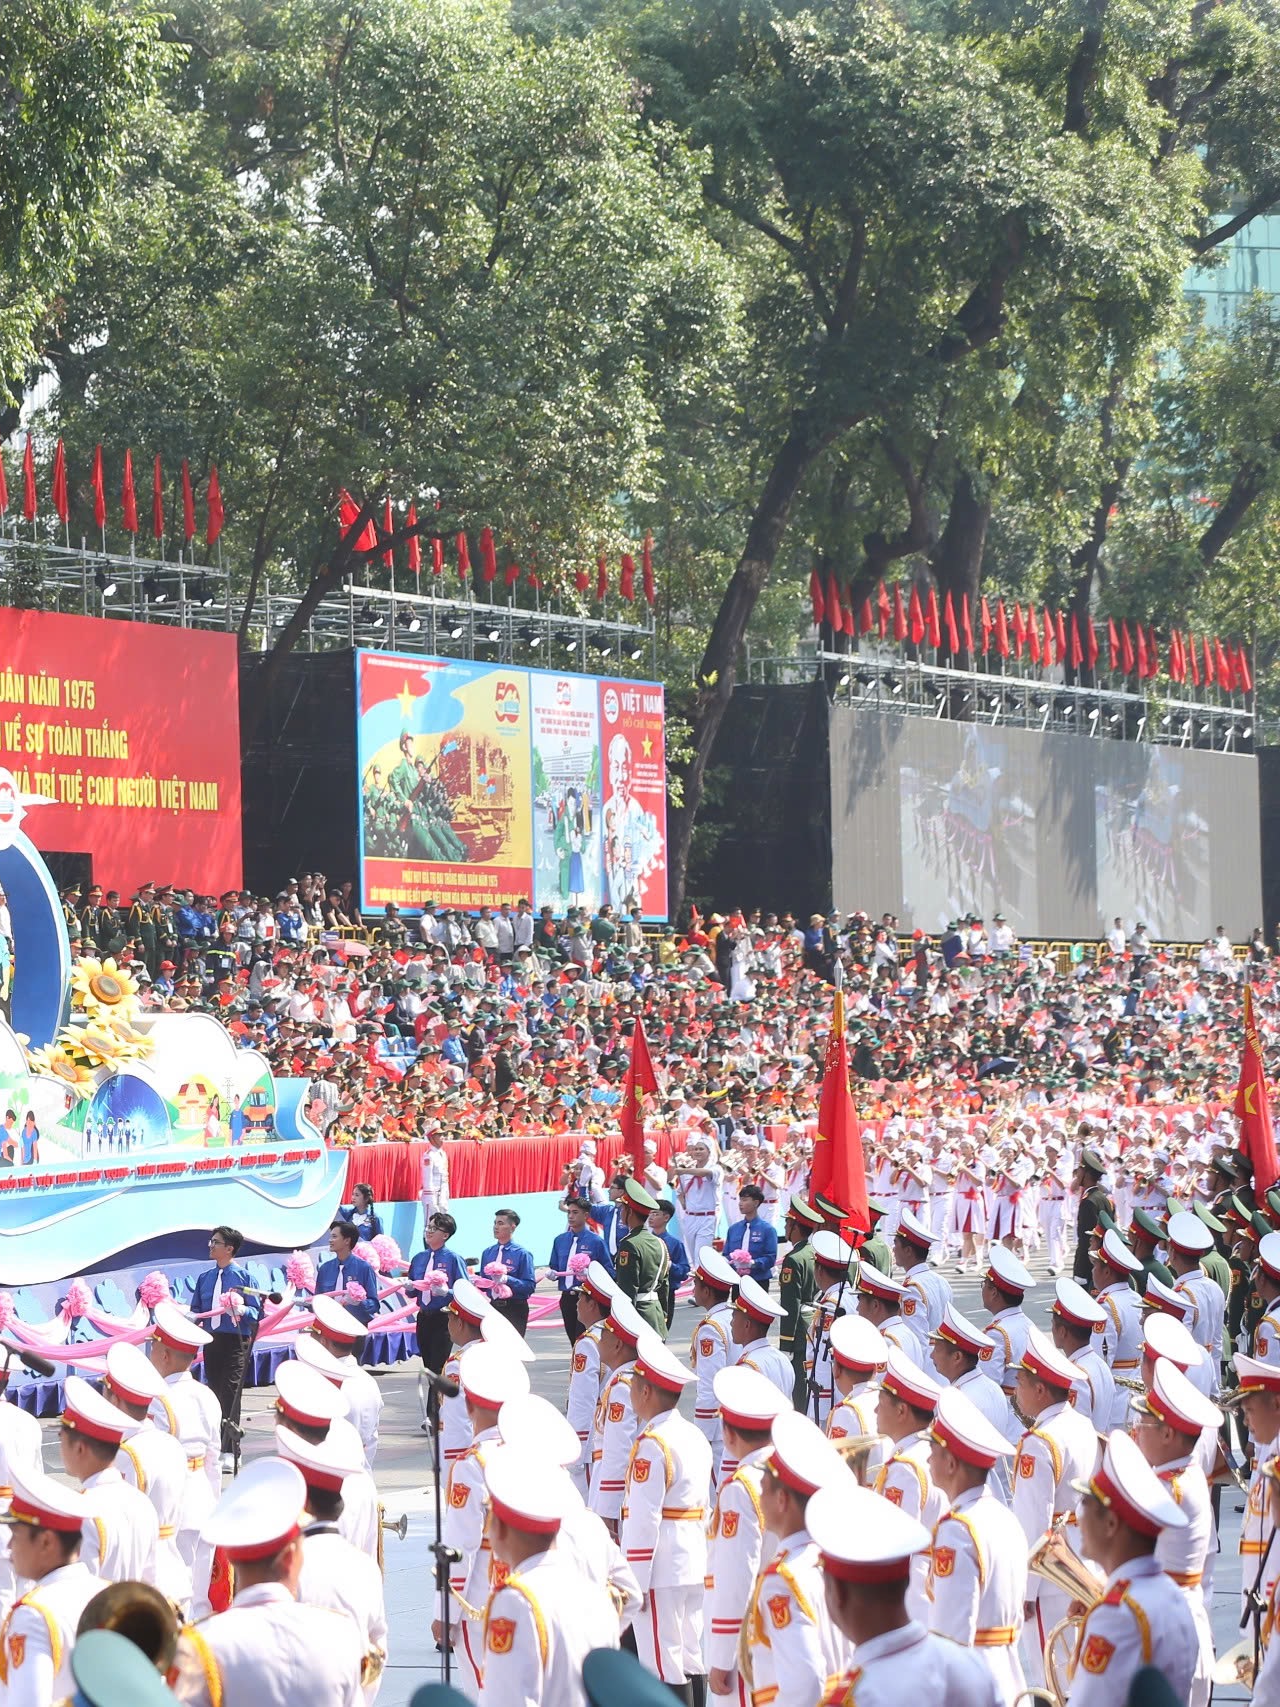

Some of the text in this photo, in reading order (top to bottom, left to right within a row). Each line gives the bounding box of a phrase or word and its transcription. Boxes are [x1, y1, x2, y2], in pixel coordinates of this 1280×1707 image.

[28, 669, 60, 707] NĂM
[63, 679, 95, 710] 1975
[621, 688, 641, 715] VIỆT
[643, 694, 663, 714] NAM
[4, 712, 22, 751] VỀ
[25, 721, 45, 760] SỰ
[47, 720, 82, 757] TOÀN
[85, 718, 128, 760] THẮNG
[34, 767, 56, 799] TRÍ
[59, 769, 83, 811] TUỆ
[87, 776, 114, 805] CON
[117, 771, 157, 808] NGƯỜI
[160, 774, 186, 815] VIỆT
[189, 782, 218, 811] NAM
